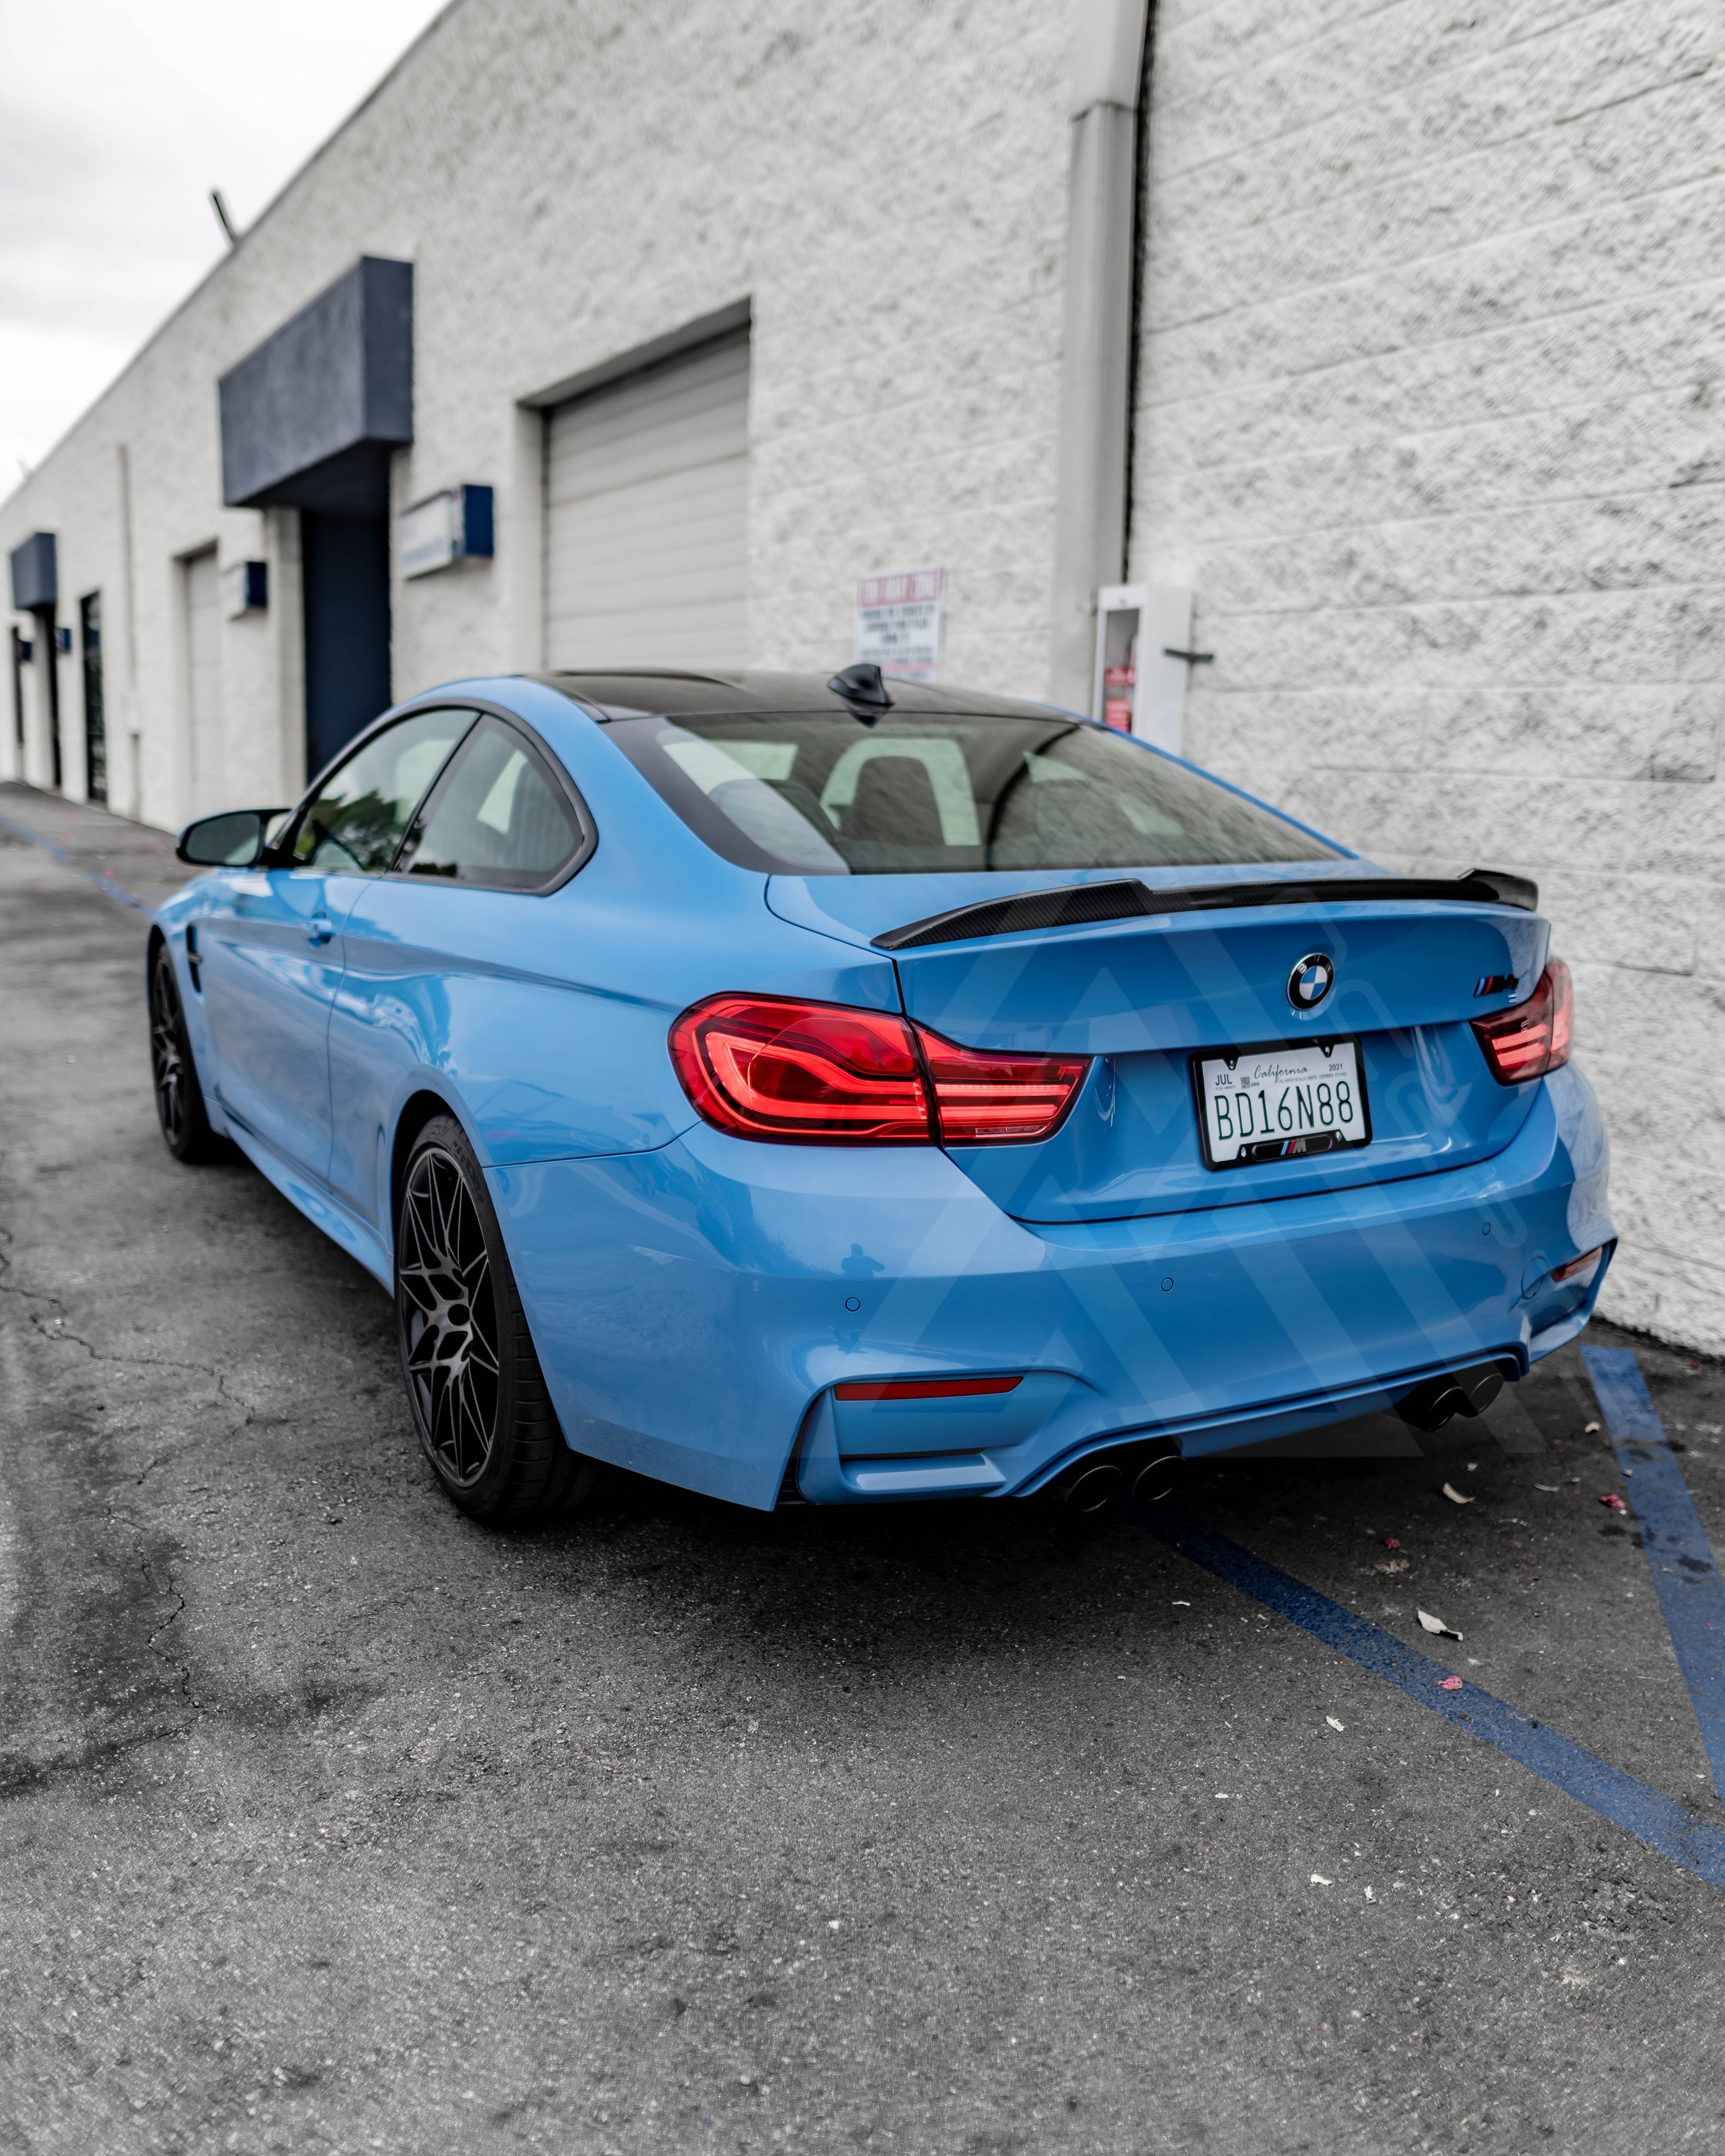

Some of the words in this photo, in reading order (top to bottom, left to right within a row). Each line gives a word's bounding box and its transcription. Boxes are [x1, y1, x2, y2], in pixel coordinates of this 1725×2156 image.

[1254, 1064, 1308, 1084] California
[1329, 1063, 1343, 1072] 2021
[1215, 1074, 1233, 1086] JUL
[1214, 1081, 1353, 1141] BD16N88
